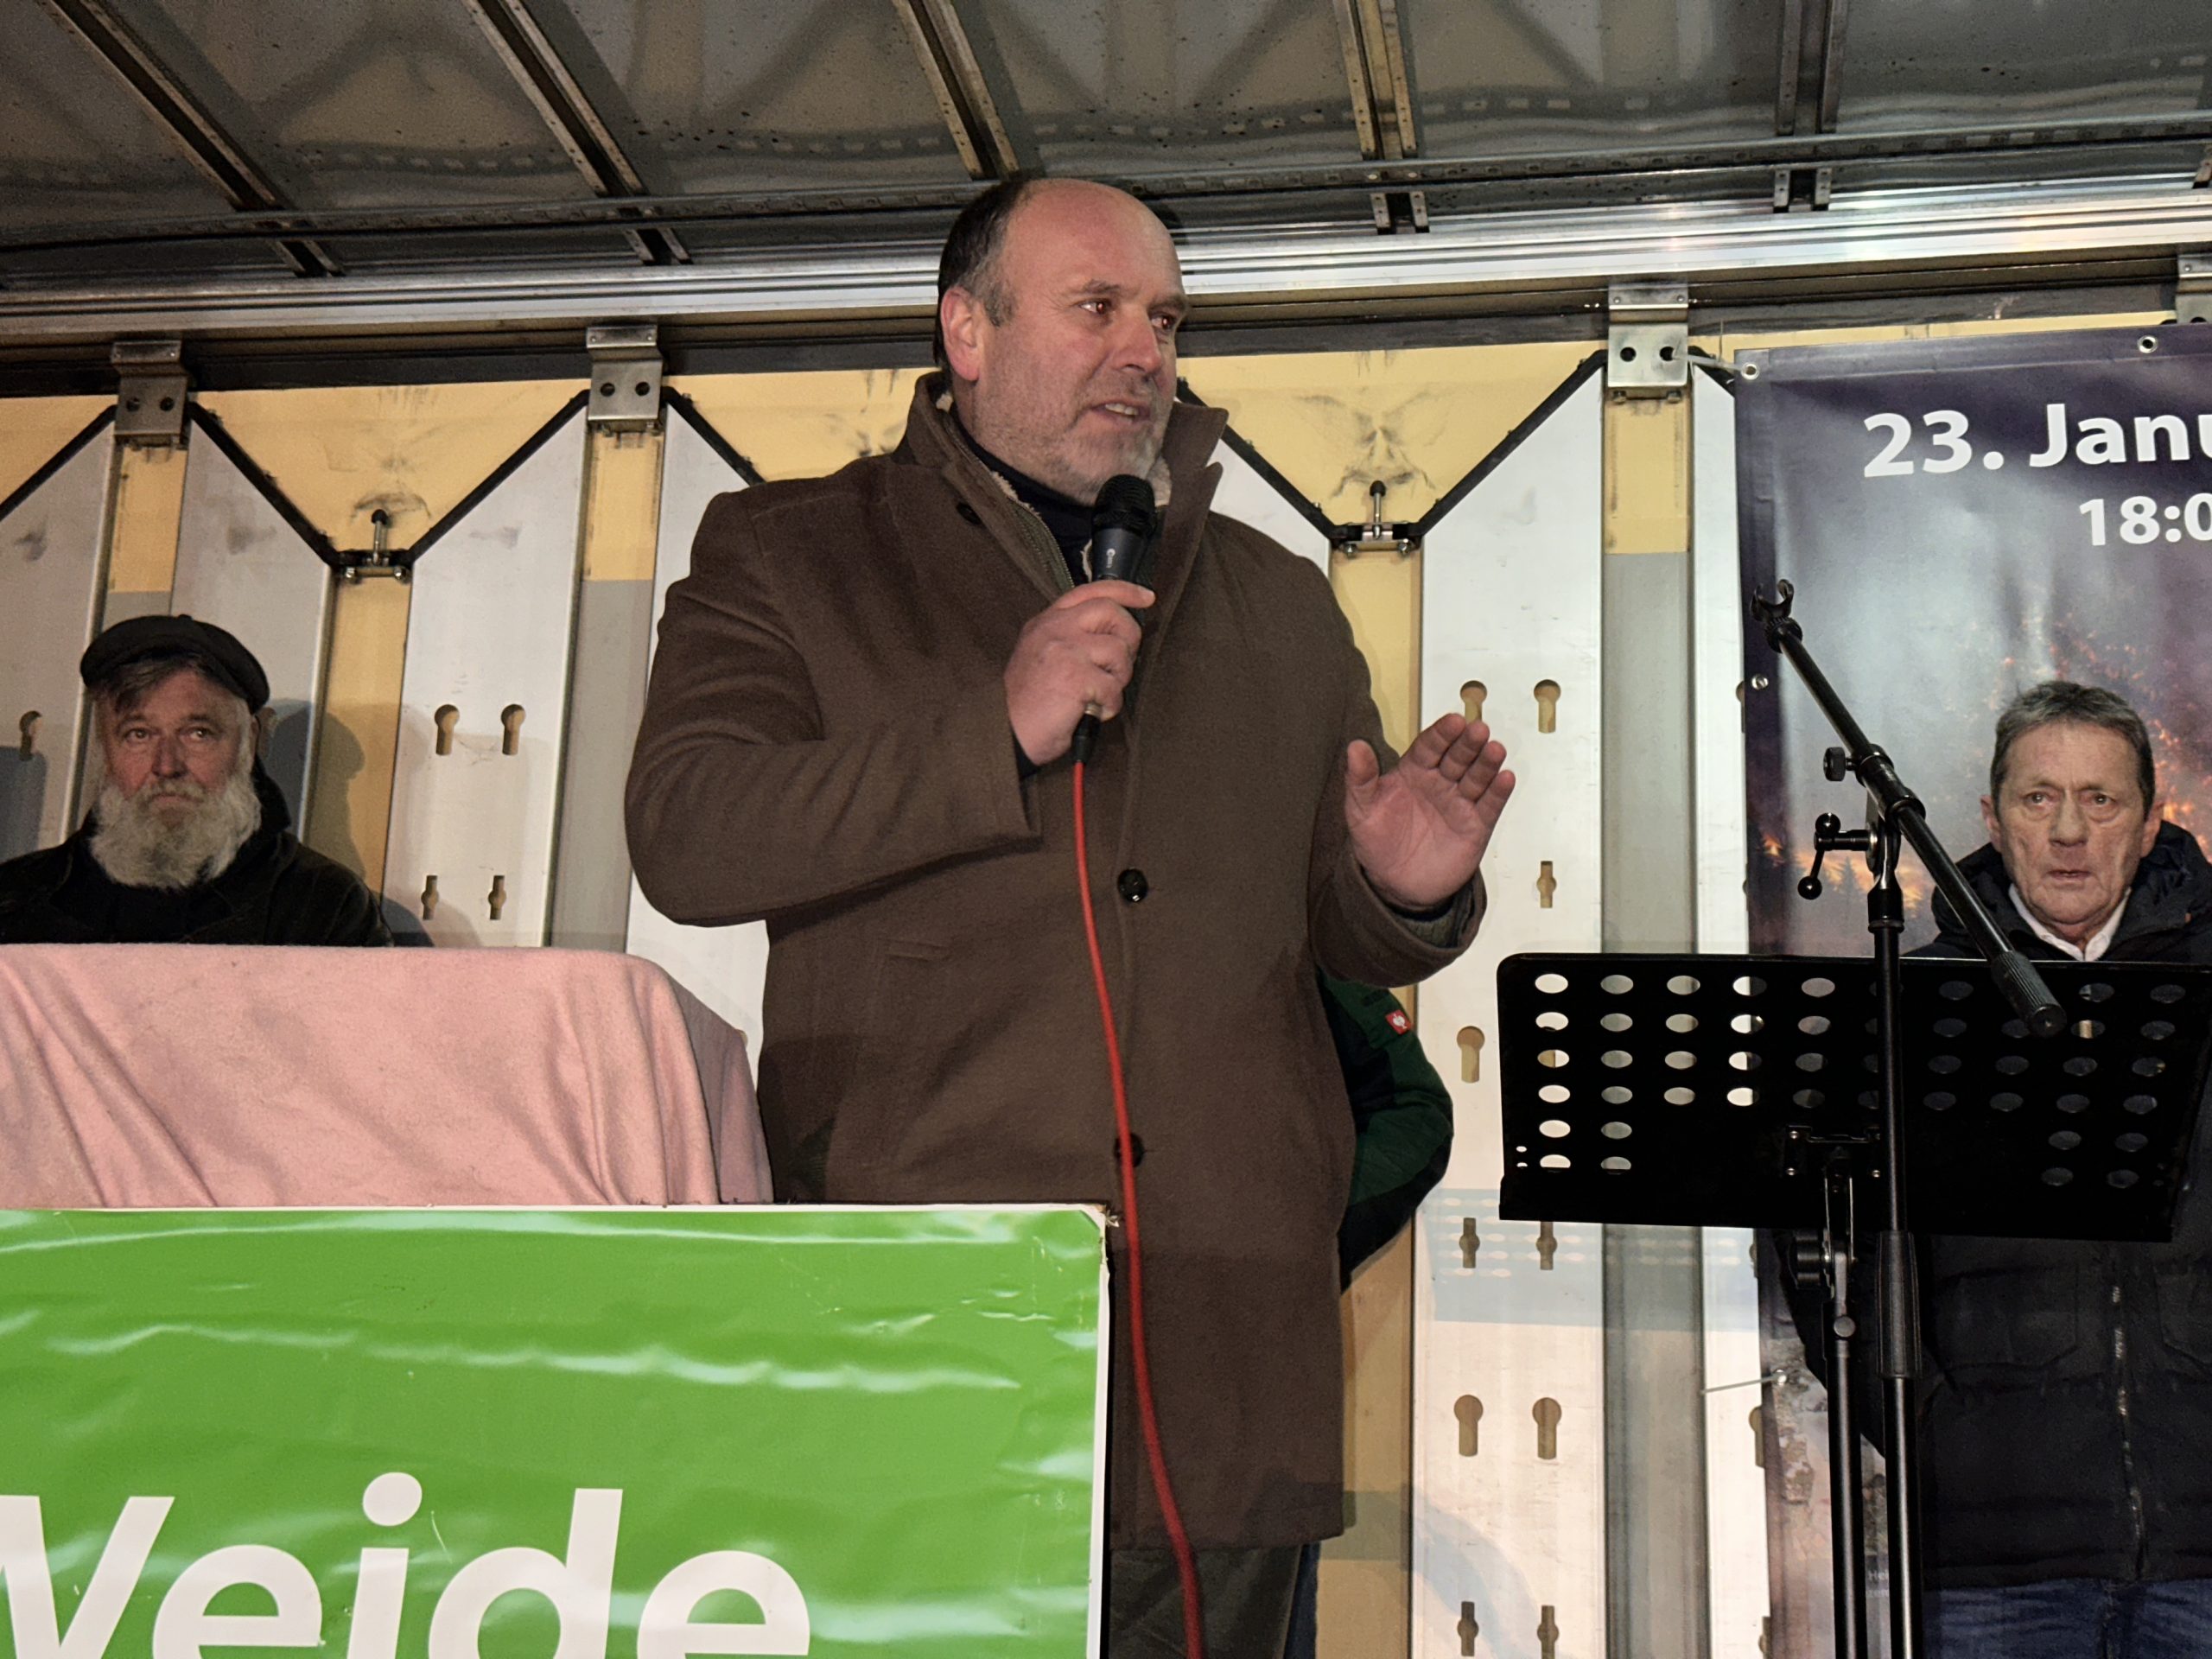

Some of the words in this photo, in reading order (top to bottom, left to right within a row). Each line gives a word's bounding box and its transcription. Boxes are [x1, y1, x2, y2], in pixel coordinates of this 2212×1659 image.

[1863, 410, 2005, 478] 23.
[2029, 403, 2212, 467] Jan
[2079, 493, 2212, 546] 18:0
